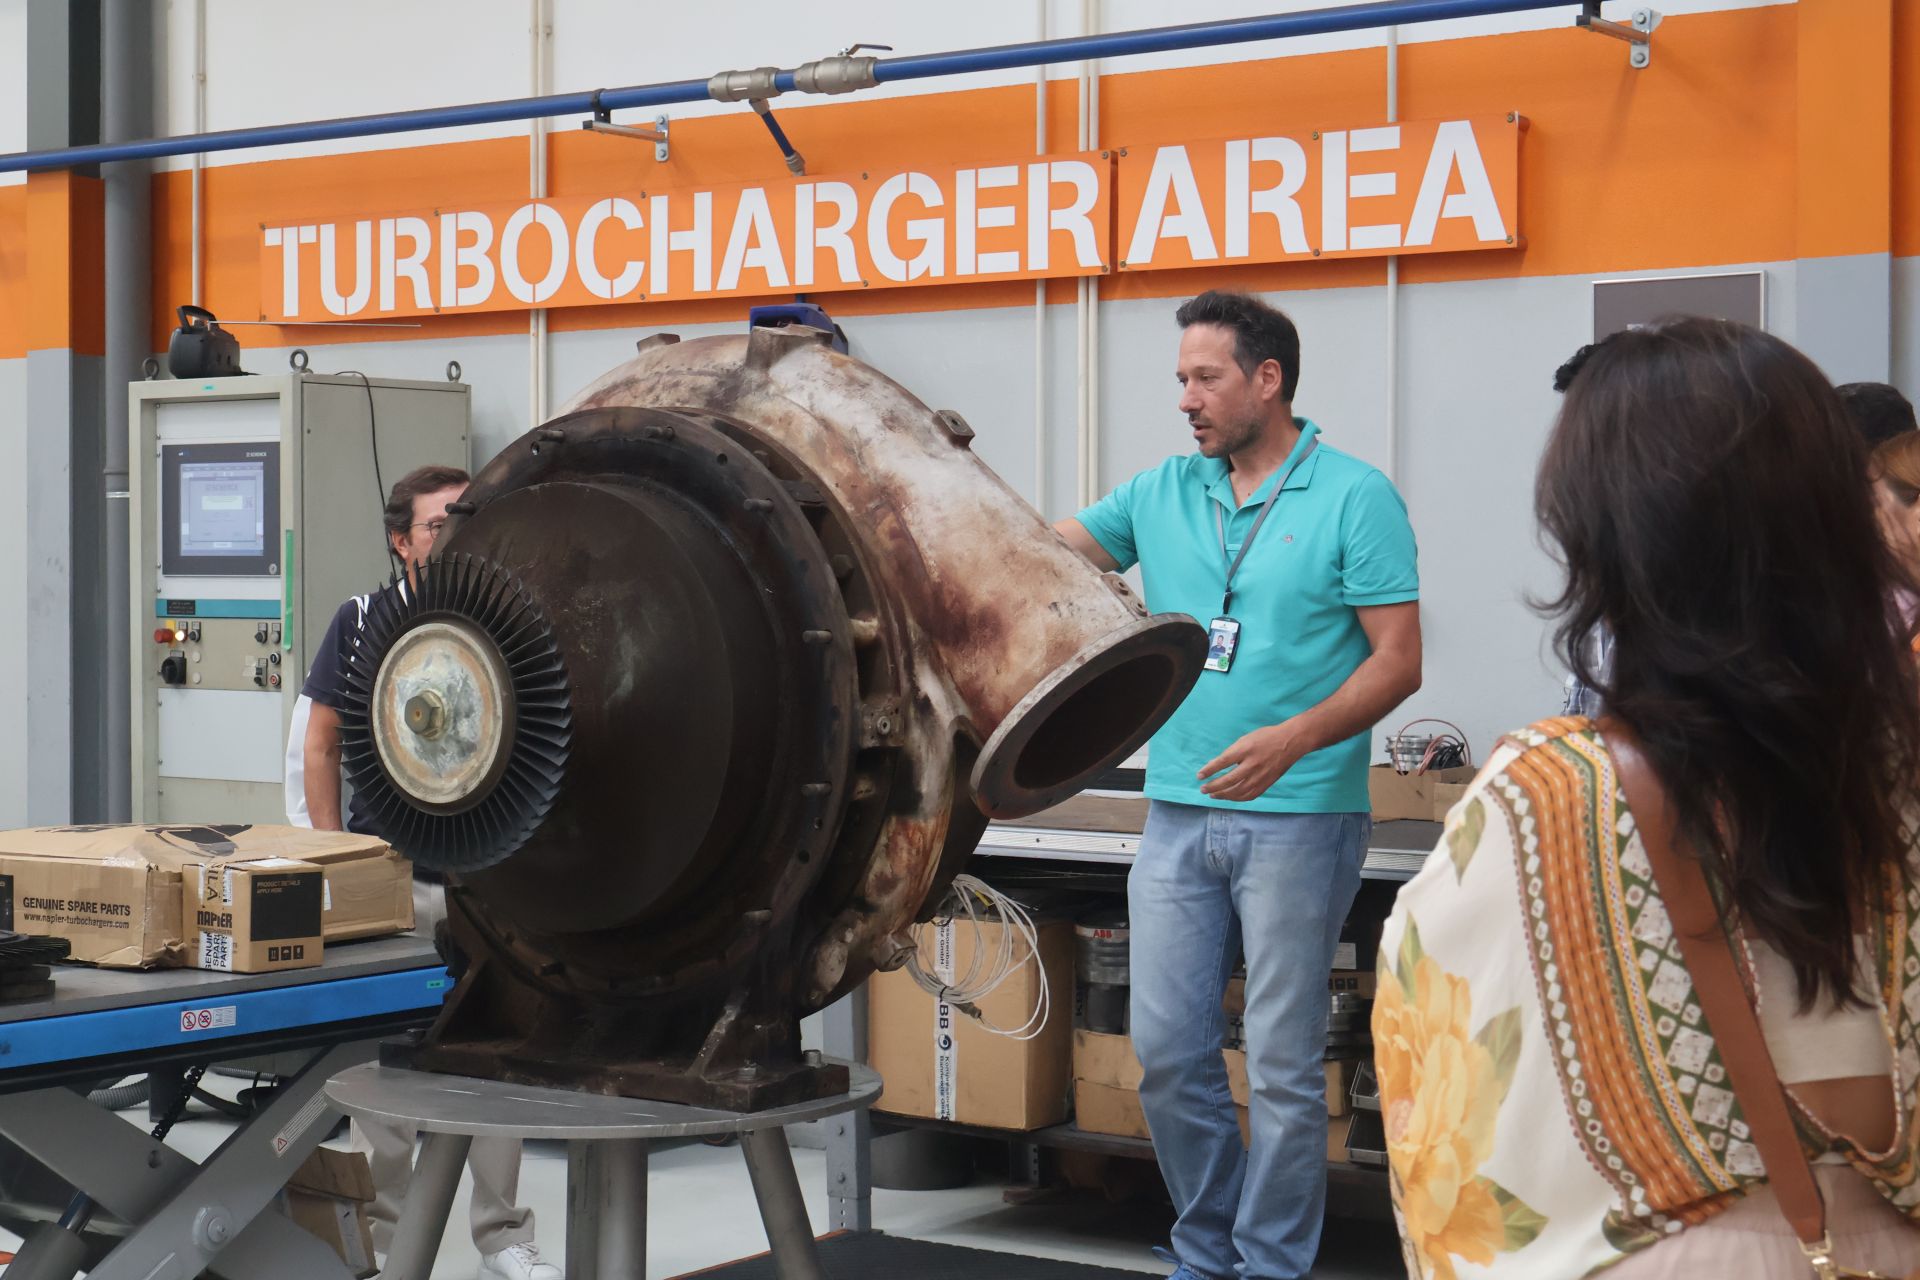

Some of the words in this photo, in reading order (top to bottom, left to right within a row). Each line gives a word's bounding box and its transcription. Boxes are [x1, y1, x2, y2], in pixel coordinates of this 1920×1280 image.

[264, 159, 1105, 318] TURBOCHARGER
[1125, 119, 1508, 265] AREA
[23, 896, 65, 912] GENUINE
[67, 900, 98, 915] SPARE
[100, 903, 131, 917] PARTS
[23, 912, 130, 929] www.napier-turbochargers.com
[1093, 929, 1112, 938] ABB
